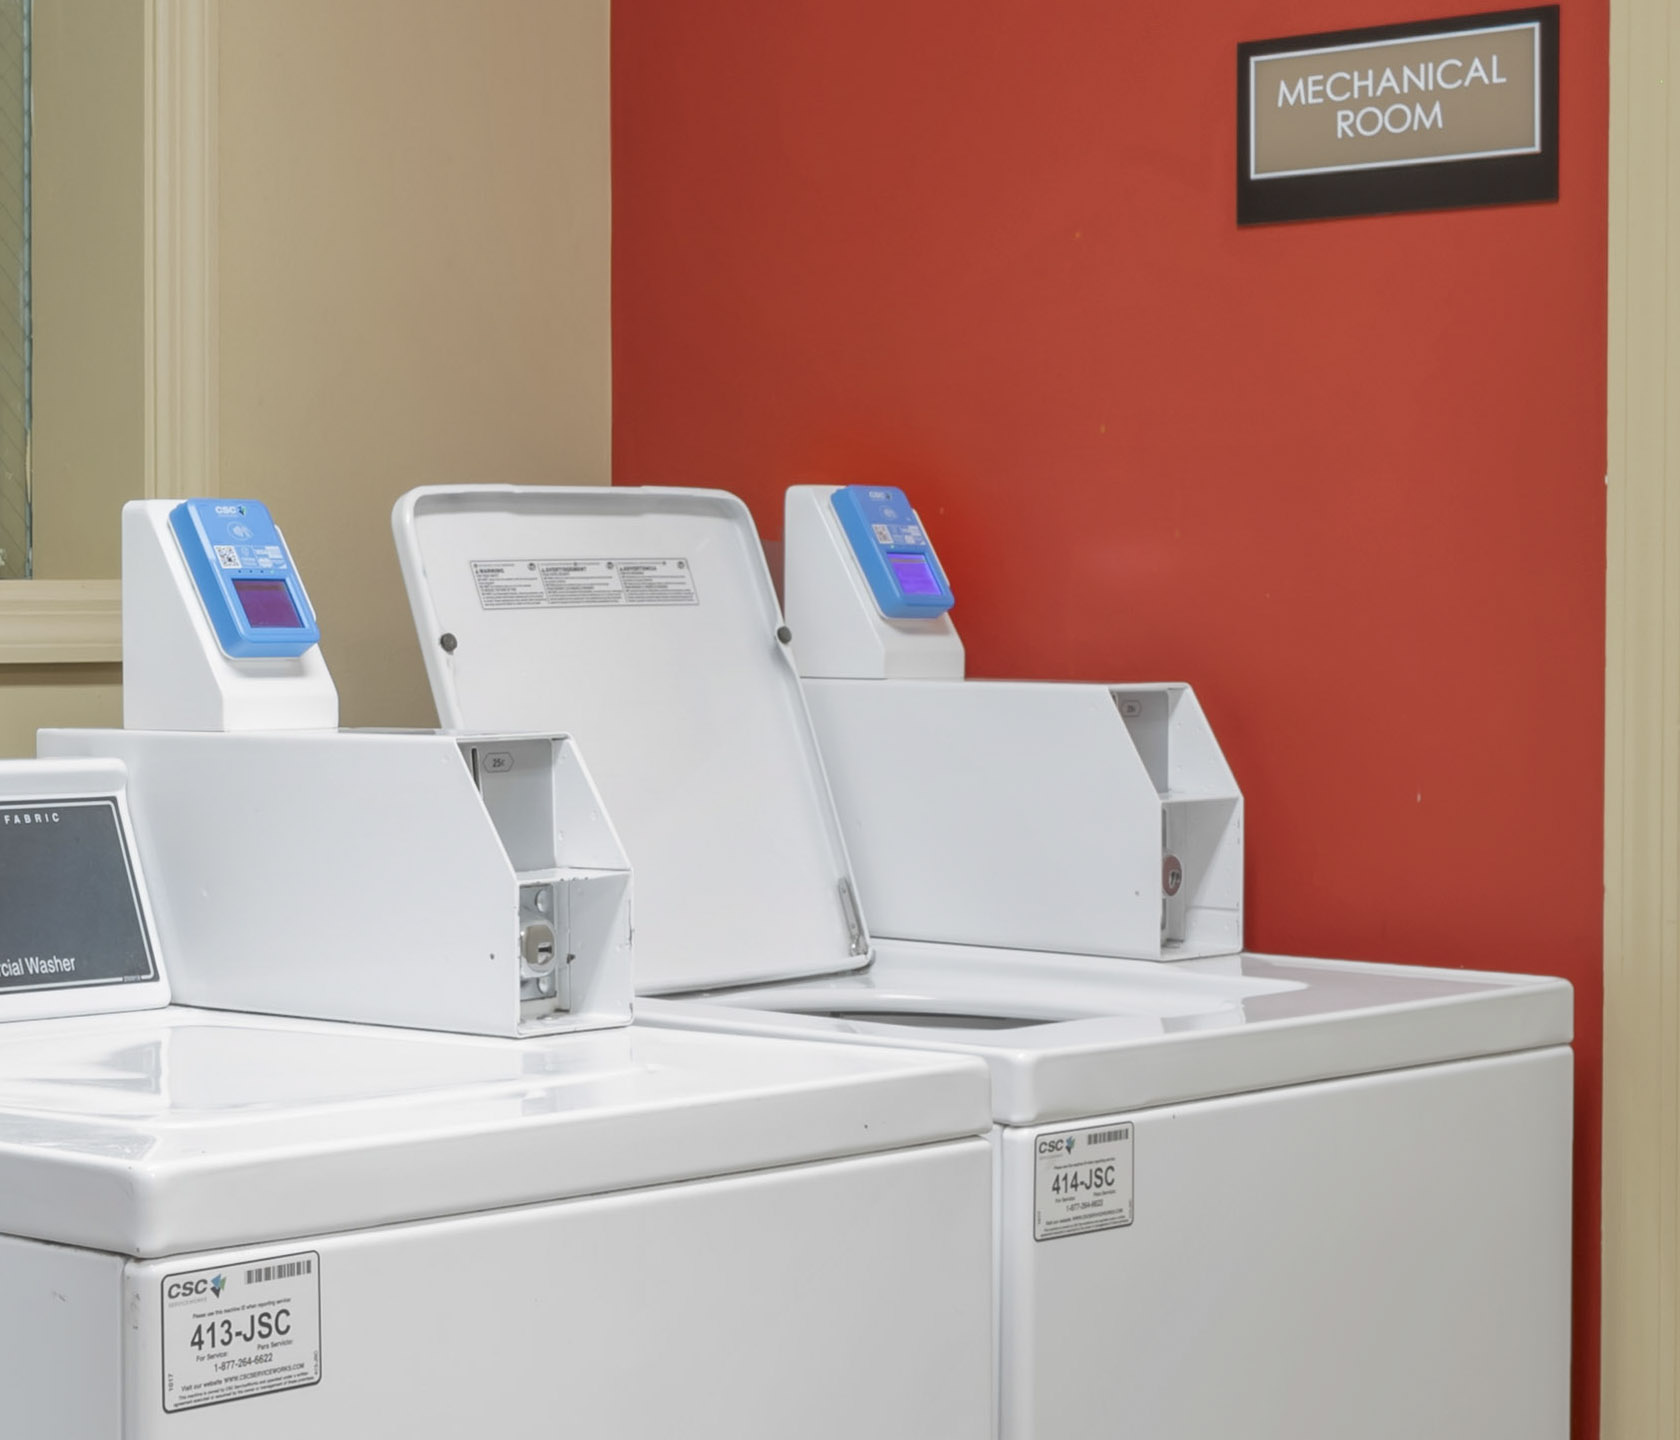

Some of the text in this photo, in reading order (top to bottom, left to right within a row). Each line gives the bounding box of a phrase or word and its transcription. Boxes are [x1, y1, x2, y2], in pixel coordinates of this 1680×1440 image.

[1277, 54, 1506, 108] MECHANICAL
[1337, 100, 1443, 139] ROOM
[4, 812, 60, 825] FABRIC
[24, 955, 76, 975] Washer
[1039, 1139, 1064, 1154] CSC
[1051, 1165, 1115, 1195] 414-JSC
[167, 1279, 208, 1299] CSC
[190, 1308, 291, 1351] 413-JSC
